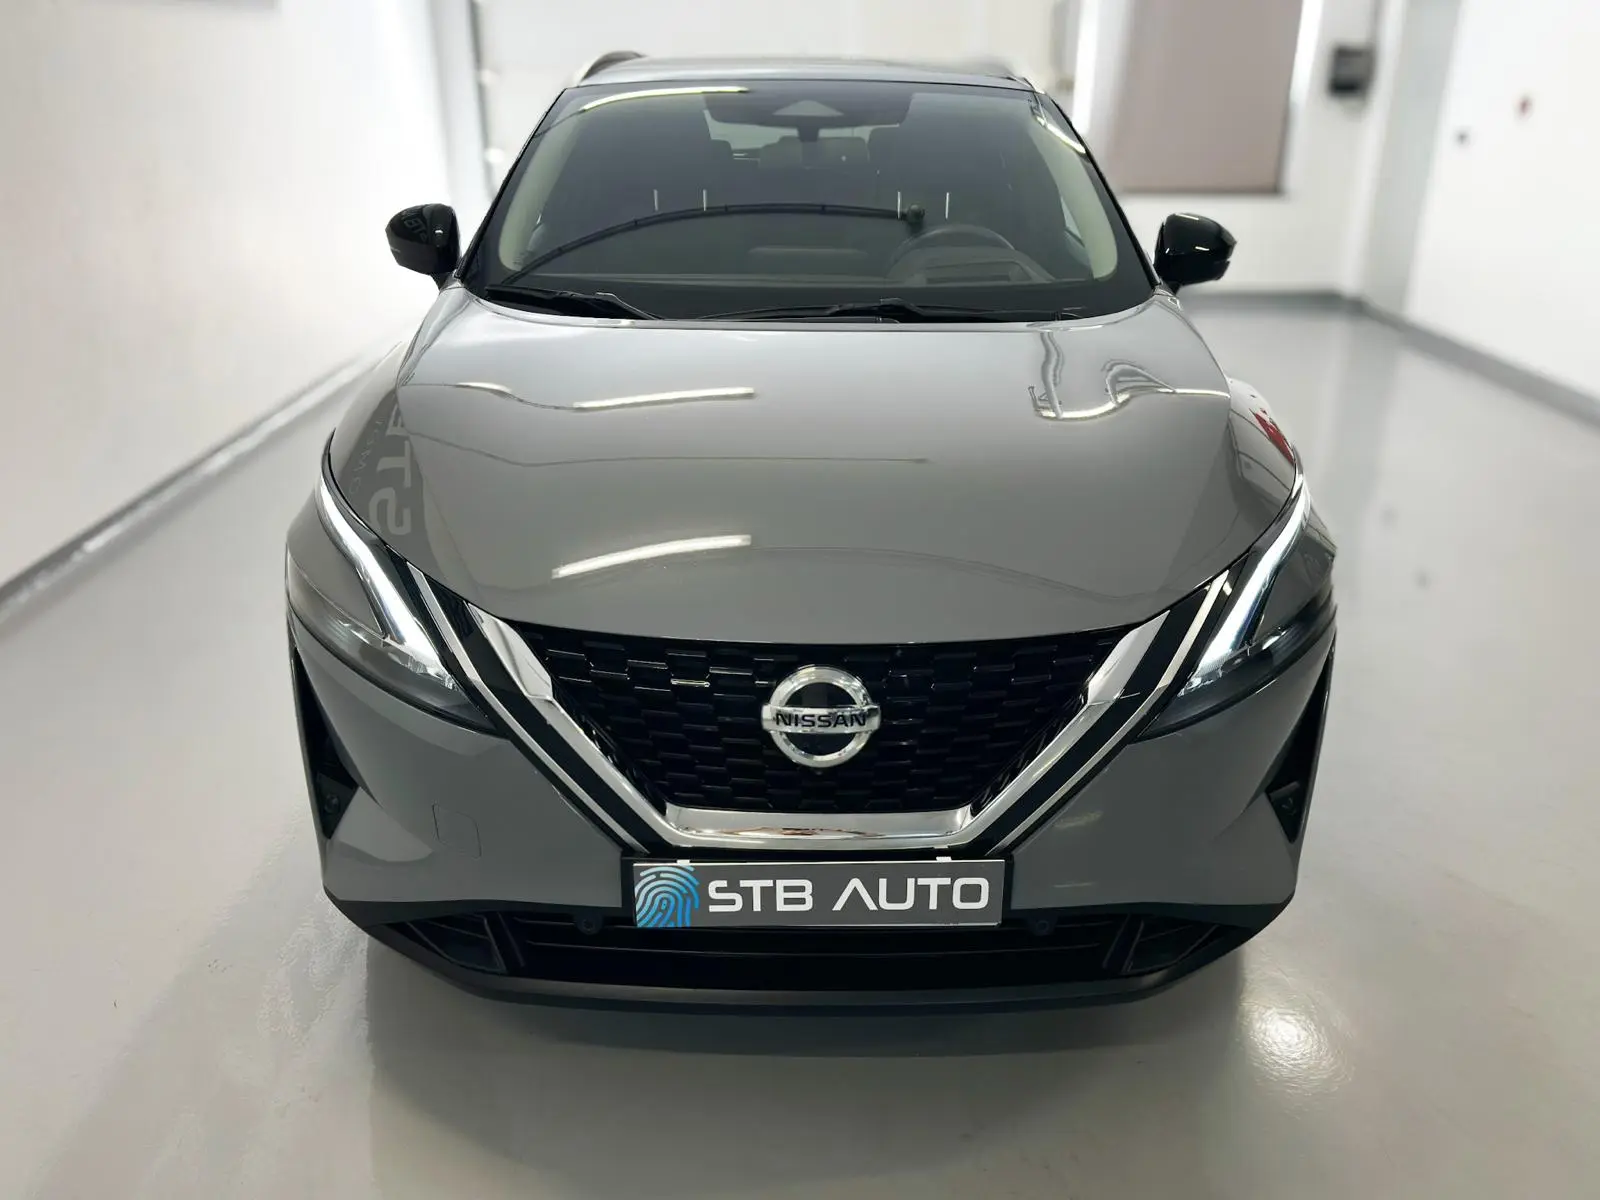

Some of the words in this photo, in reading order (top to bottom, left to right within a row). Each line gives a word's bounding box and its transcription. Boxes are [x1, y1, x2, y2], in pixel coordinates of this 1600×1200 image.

[775, 713, 867, 728] NISSAN
[708, 879, 813, 912] STB
[832, 877, 989, 911] AUTO
